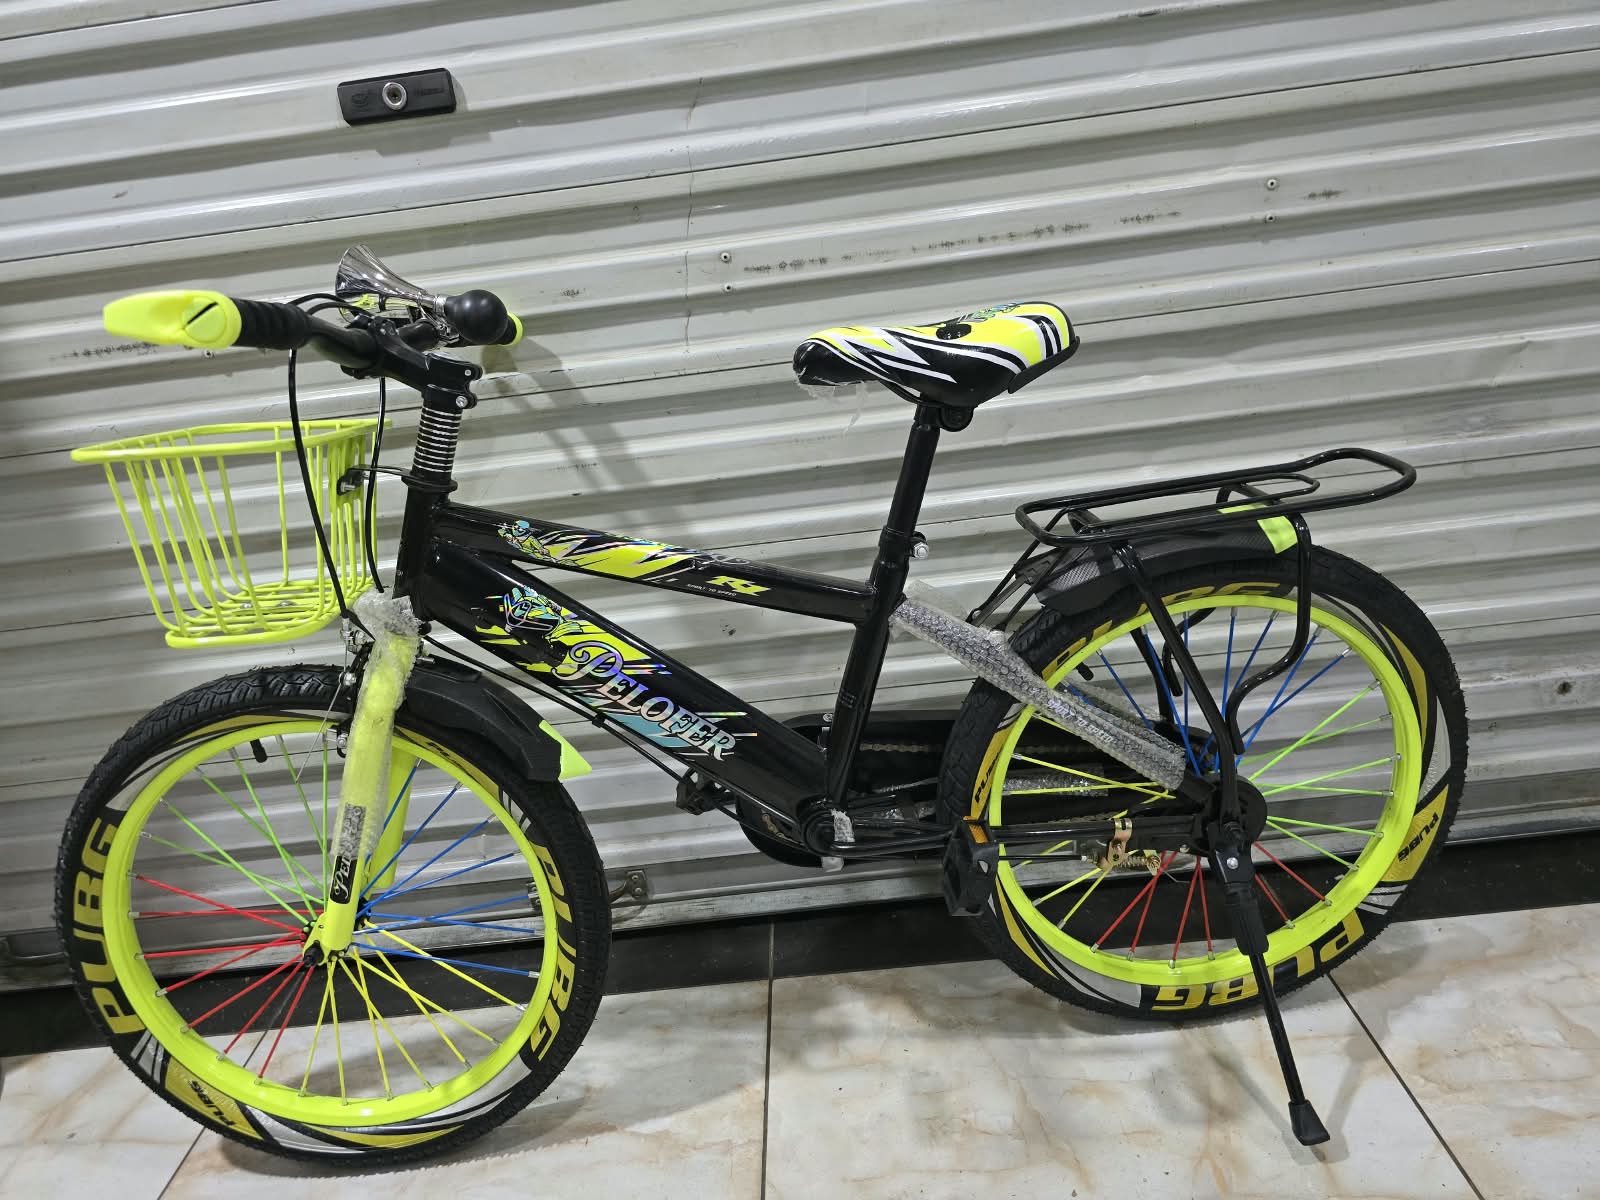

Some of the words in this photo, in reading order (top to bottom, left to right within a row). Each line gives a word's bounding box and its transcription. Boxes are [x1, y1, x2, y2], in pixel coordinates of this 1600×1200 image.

[551, 640, 737, 761] PELOFER
[1397, 812, 1440, 862] PUBG
[73, 817, 146, 1034] PUBG
[529, 840, 577, 1061] PUBG
